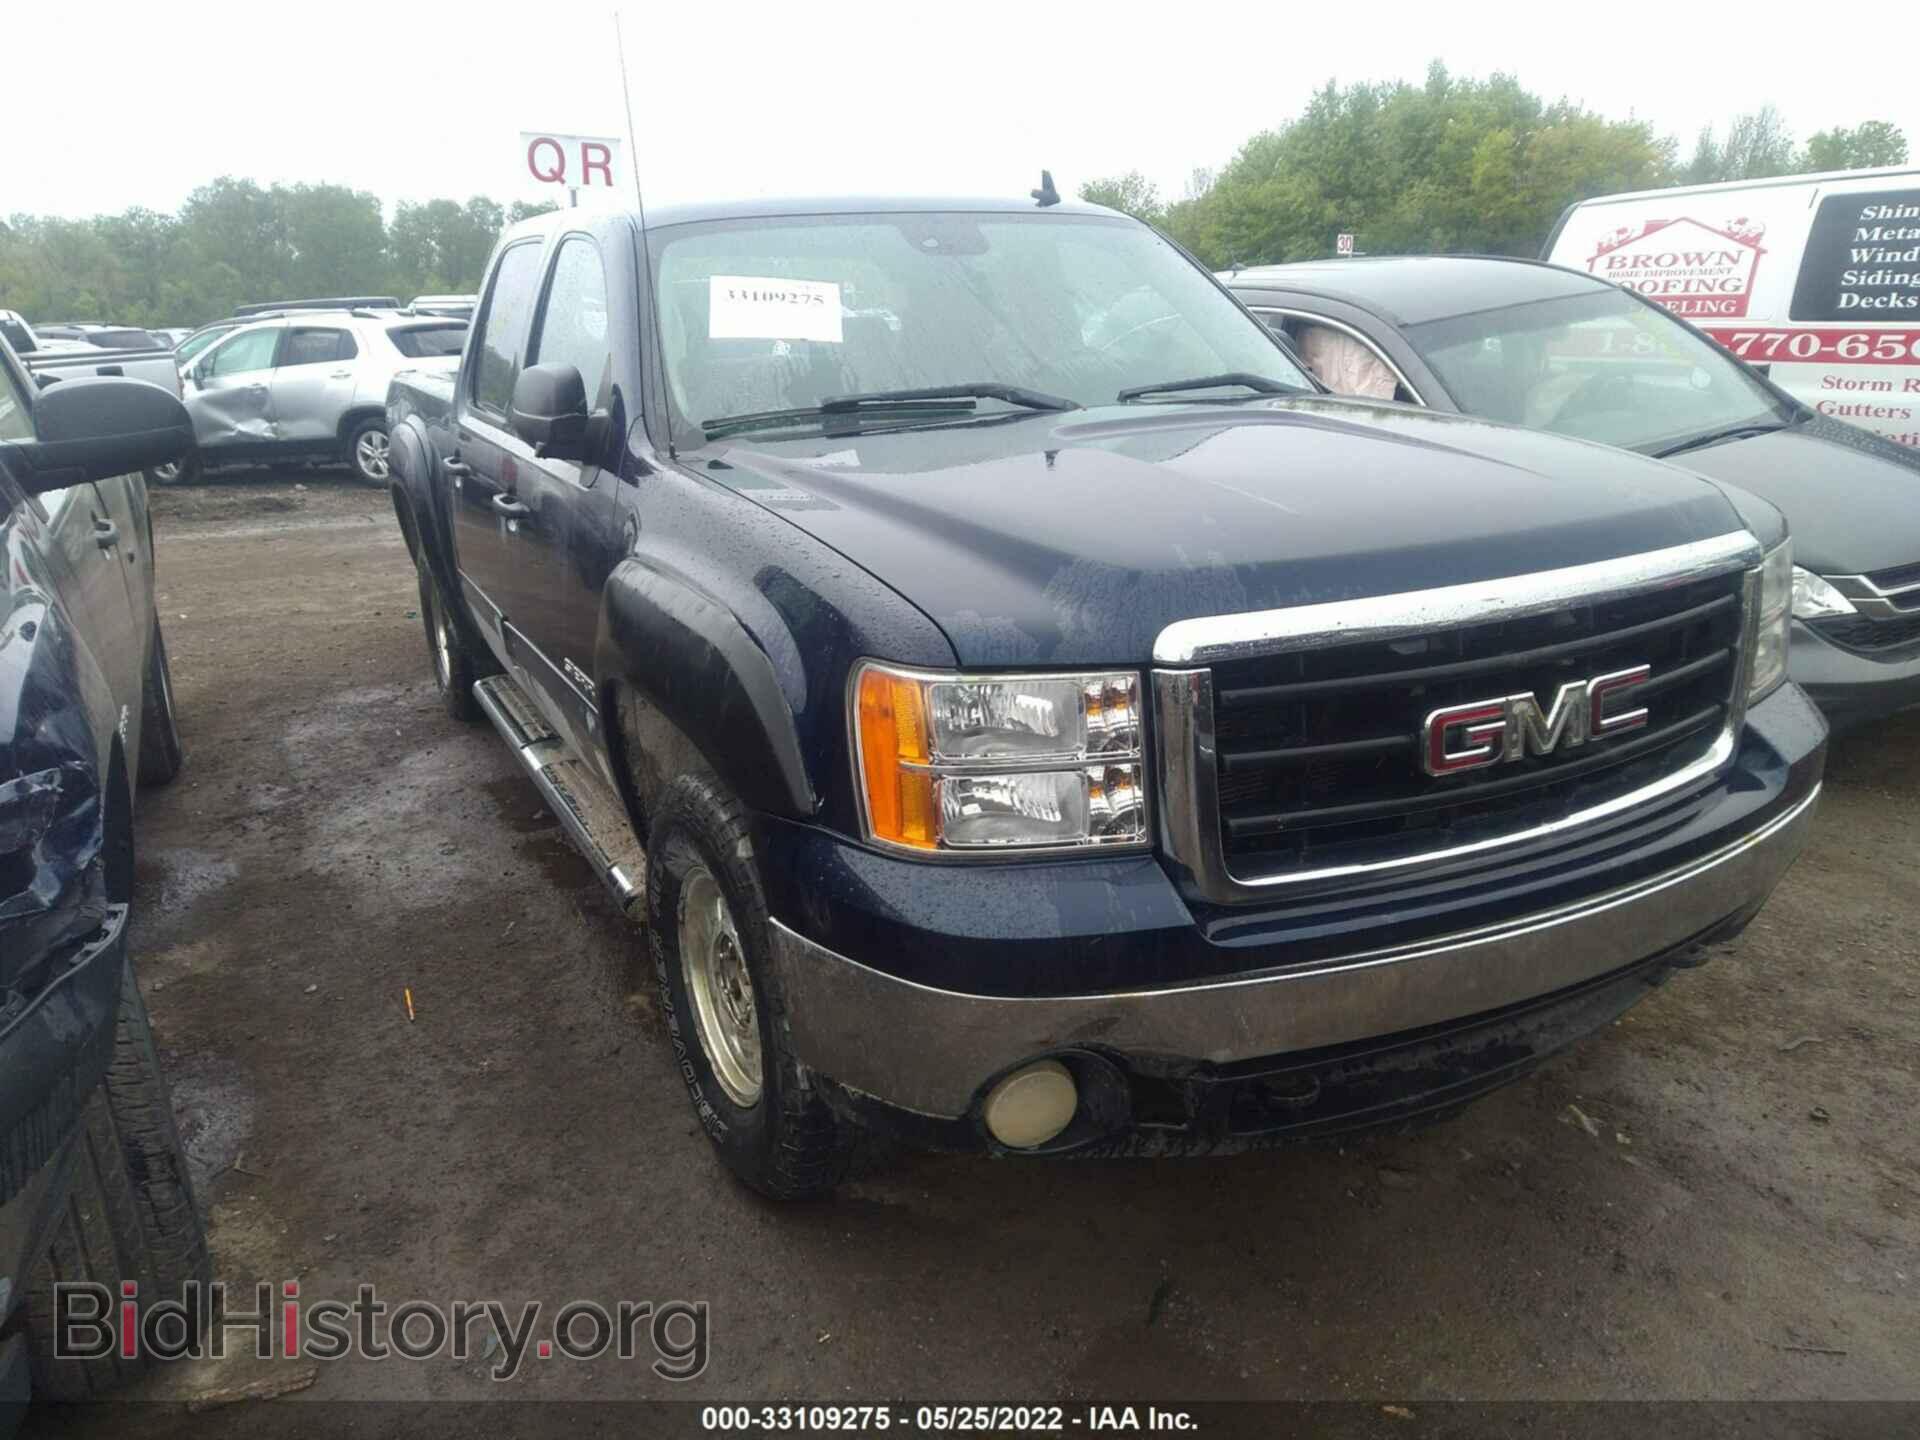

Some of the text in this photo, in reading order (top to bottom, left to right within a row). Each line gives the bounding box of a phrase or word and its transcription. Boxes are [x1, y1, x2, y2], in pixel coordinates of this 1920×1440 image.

[1859, 204, 1920, 220] Shin
[1605, 250, 1744, 270] BROWN
[1608, 266, 1734, 278] HOME IMPROVEMENT
[729, 290, 825, 304] 33109275
[1838, 292, 1920, 309] Decks
[1656, 299, 1738, 314] ELING
[1821, 374, 1893, 392] Storm
[1816, 400, 1912, 419] Gutters
[1424, 663, 1651, 777] GMC
